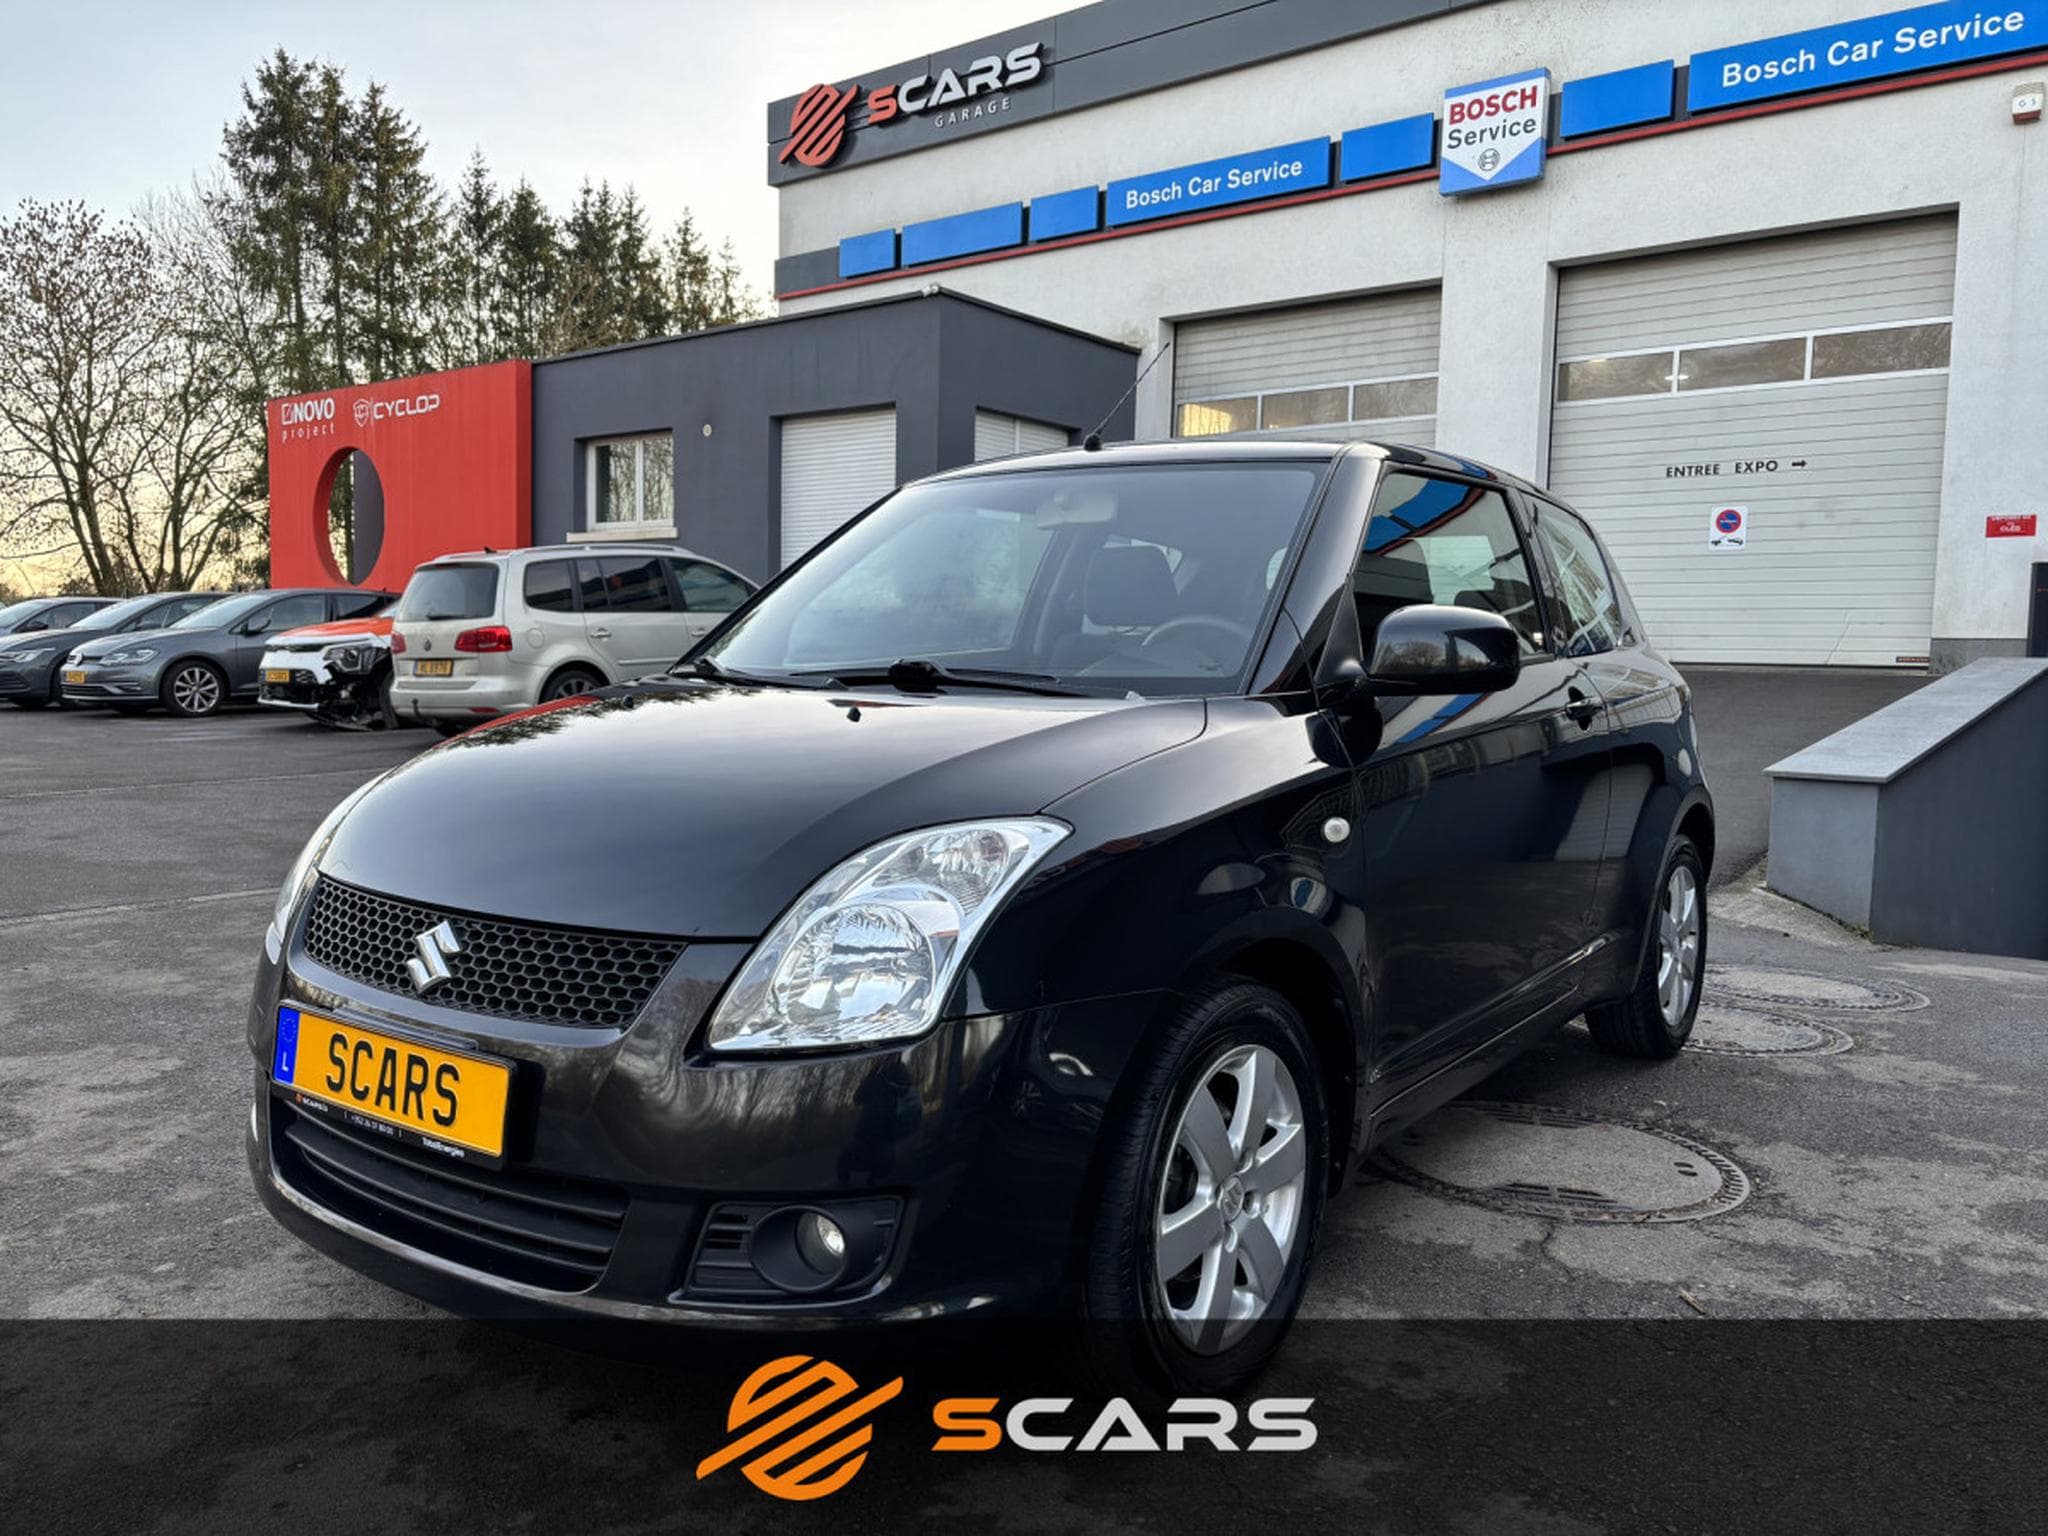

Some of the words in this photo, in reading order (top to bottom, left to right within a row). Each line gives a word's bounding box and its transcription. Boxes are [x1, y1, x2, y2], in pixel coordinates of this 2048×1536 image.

[1722, 48, 1816, 88] Bosch
[1827, 39, 1883, 66] Car
[1894, 11, 2025, 53] Service
[867, 41, 1042, 124] SCARS
[934, 97, 1012, 128] GARAGE
[1449, 85, 1538, 125] BOSCH
[1447, 118, 1537, 149] Service
[1125, 181, 1182, 209] Bosch
[1188, 176, 1222, 196] Car
[1227, 160, 1303, 189] Service
[281, 422, 335, 443] project
[1666, 463, 1721, 478] ENTREE
[1735, 460, 1778, 474] EXPO
[281, 1052, 289, 1072] L
[326, 1033, 460, 1127] SCARS
